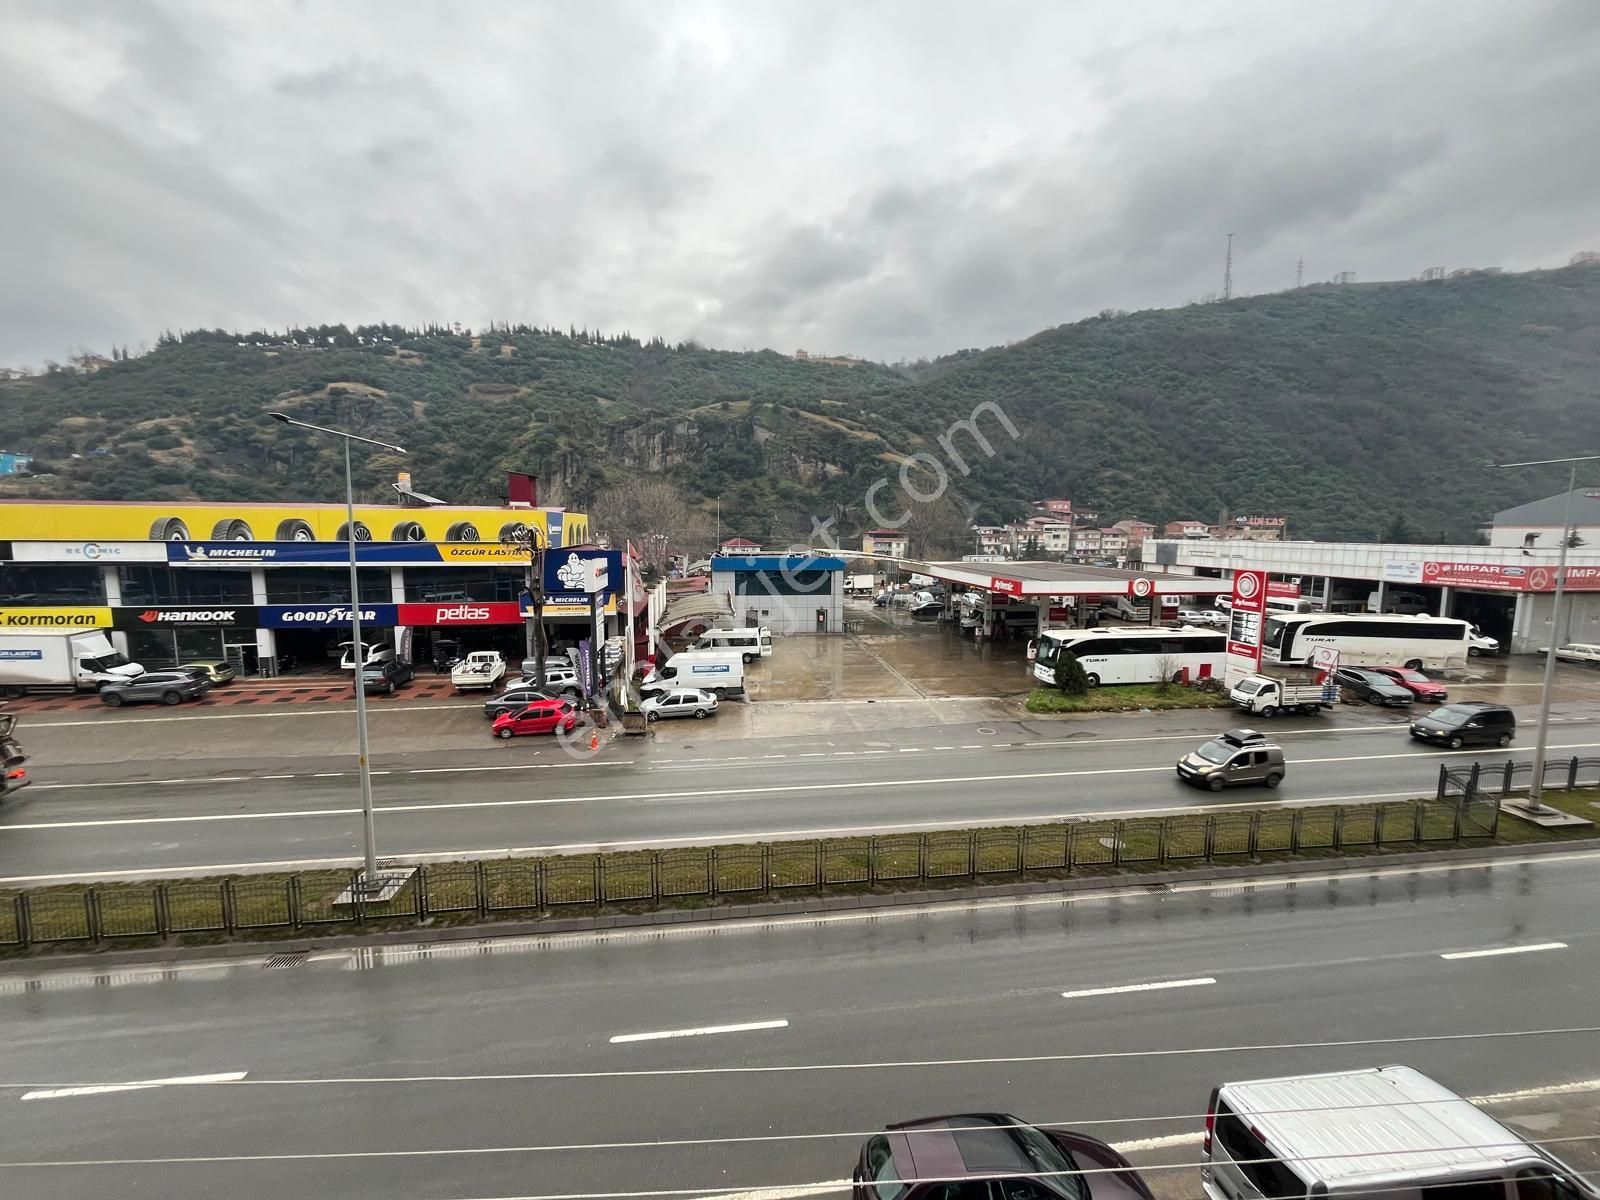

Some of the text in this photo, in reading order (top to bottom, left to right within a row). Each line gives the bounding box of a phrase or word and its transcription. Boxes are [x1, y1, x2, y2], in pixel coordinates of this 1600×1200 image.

[208, 549, 277, 557] MICHELIN
[451, 548, 486, 556] ÖZGÜR
[282, 608, 376, 623] GOODYEAR
[436, 605, 490, 623] petlas
